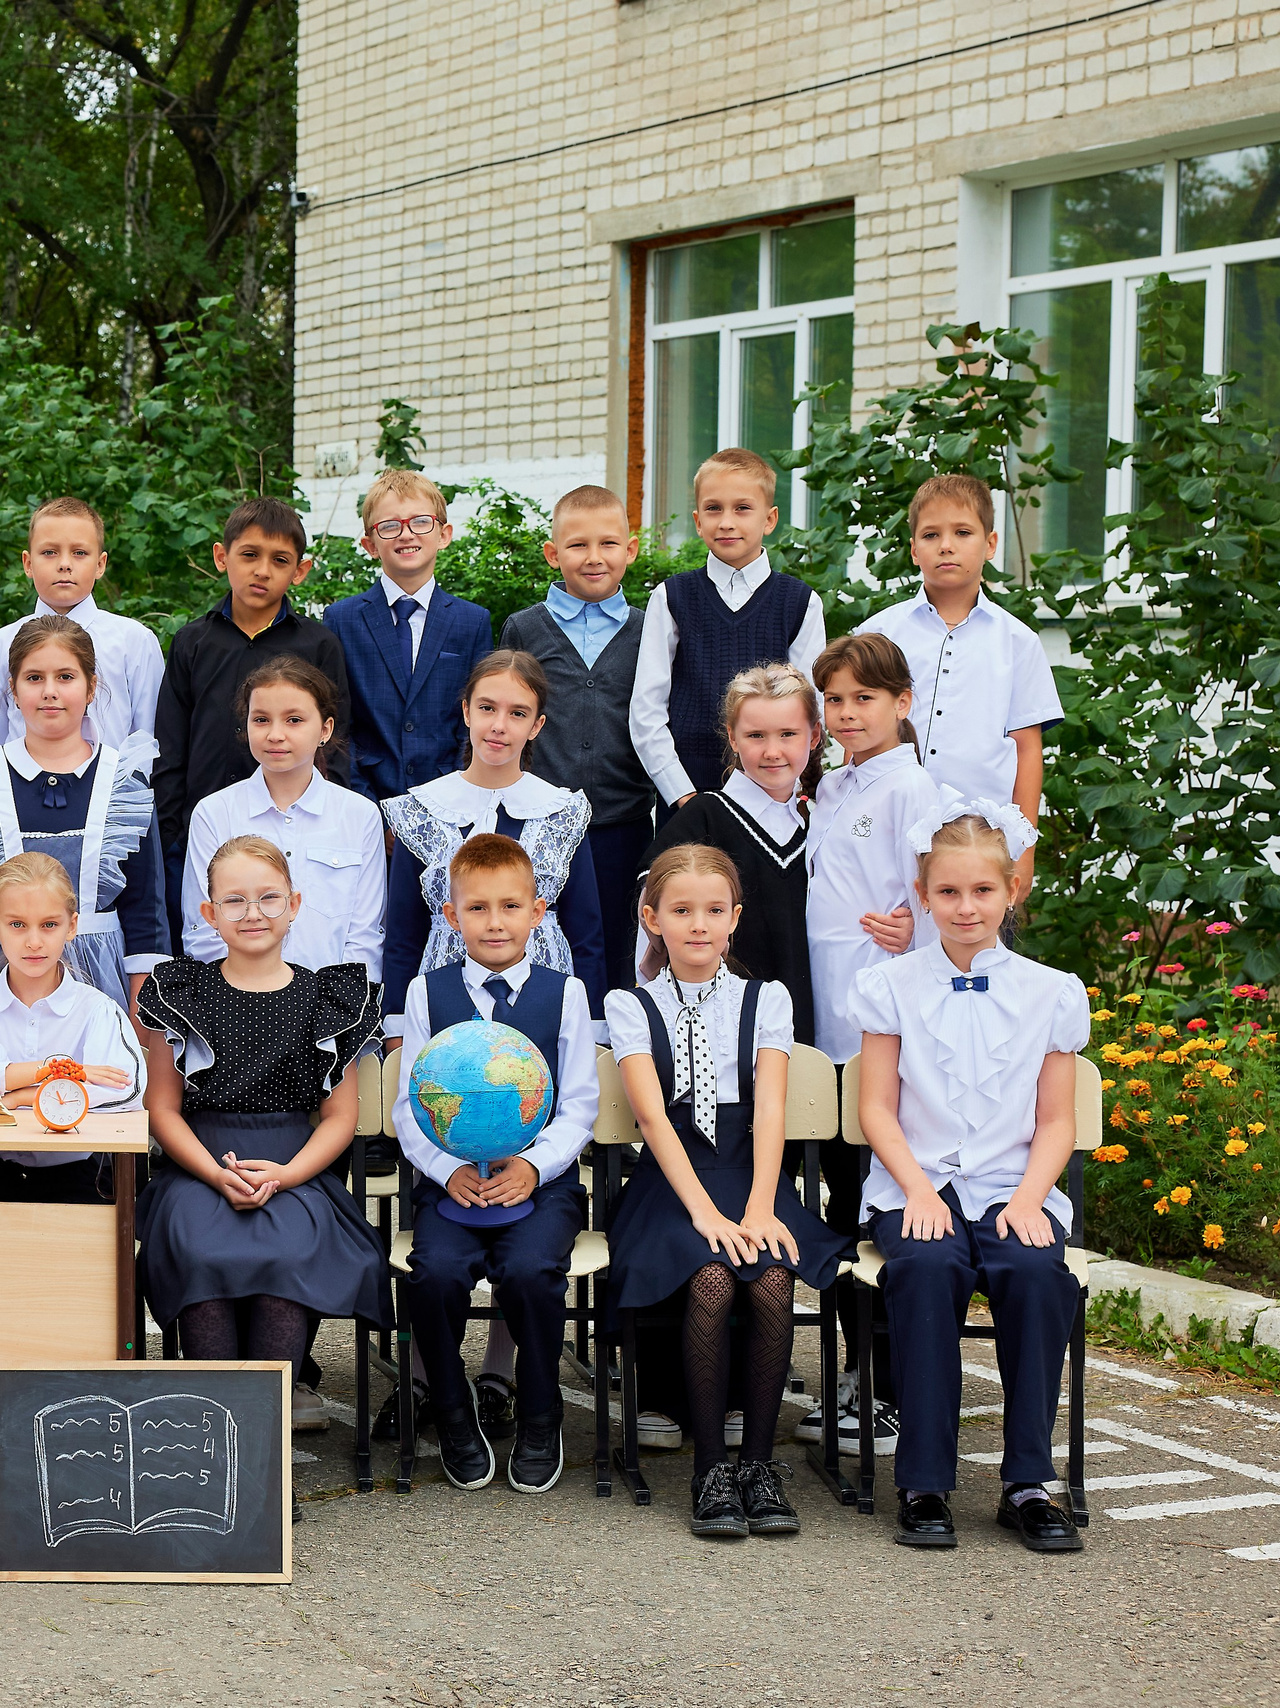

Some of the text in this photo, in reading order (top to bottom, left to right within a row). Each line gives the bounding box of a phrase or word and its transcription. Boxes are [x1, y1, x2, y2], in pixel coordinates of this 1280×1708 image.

[108, 1412, 124, 1434] 5
[201, 1411, 214, 1433] 5
[111, 1443, 125, 1463] 5
[202, 1438, 216, 1460] 4
[198, 1469, 212, 1486] 5
[108, 1487, 122, 1511] 4
